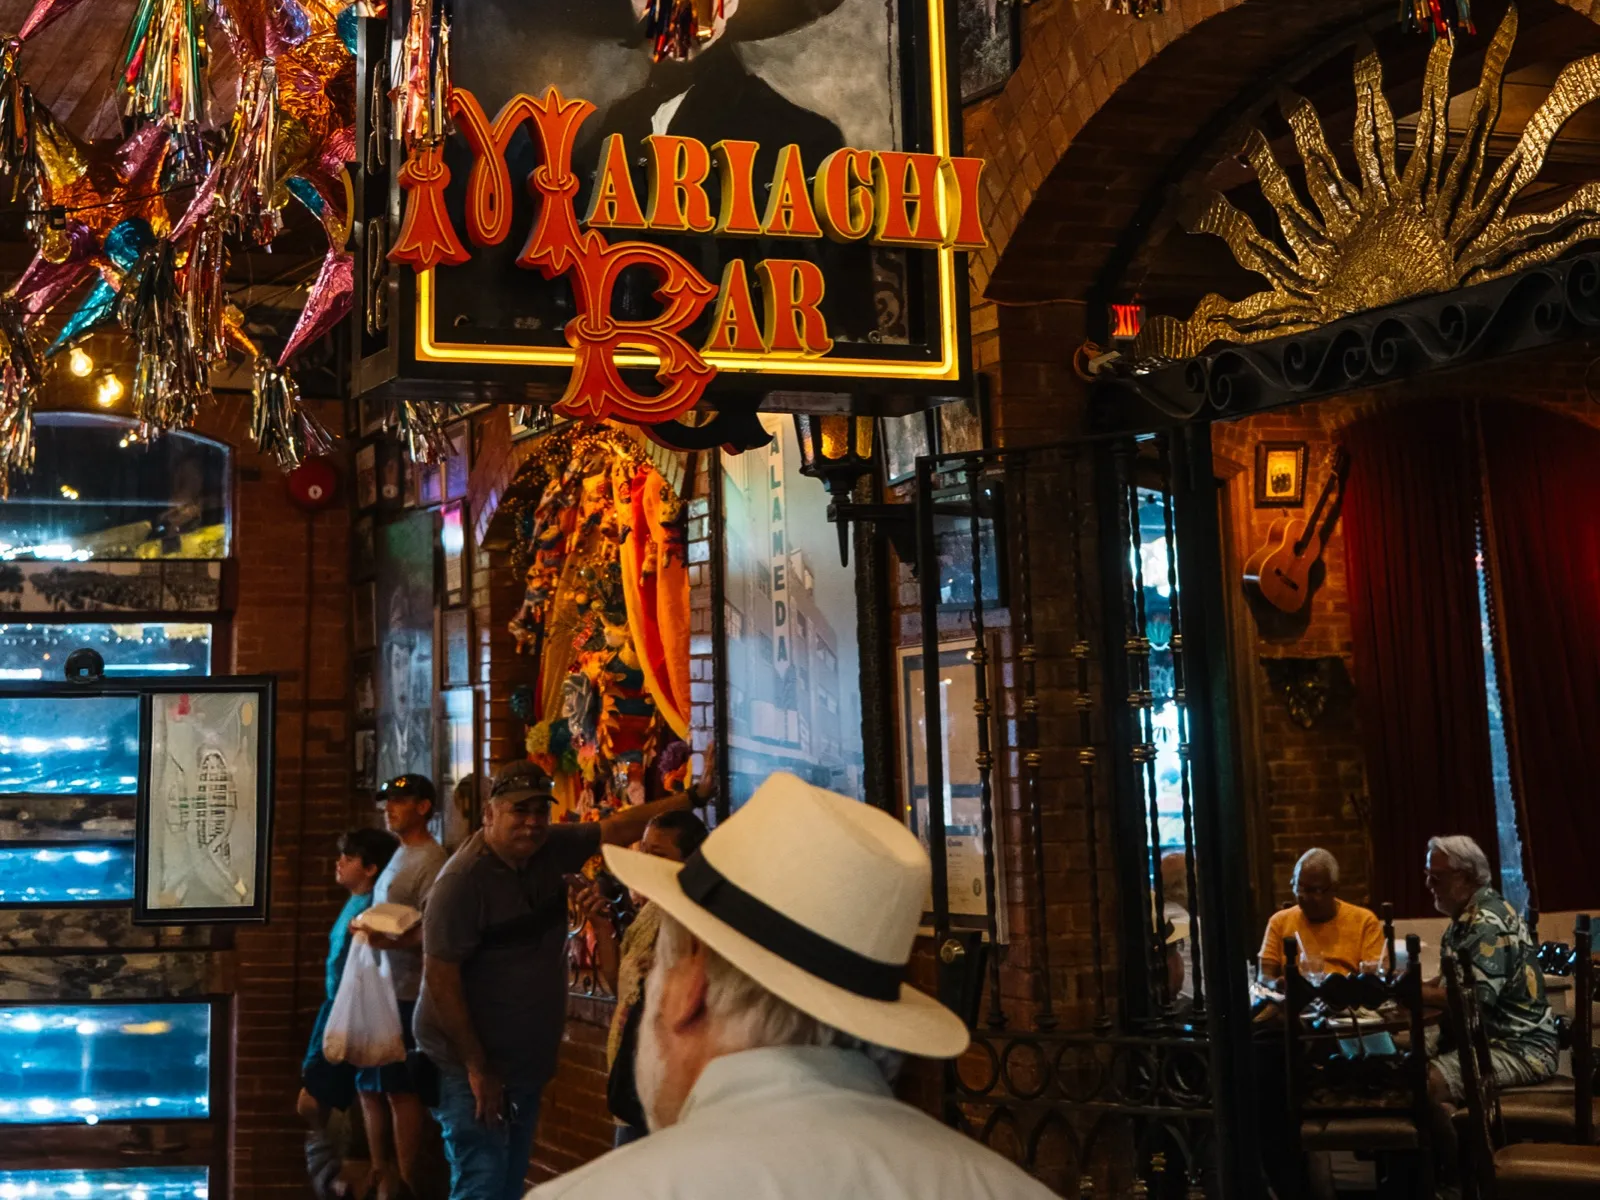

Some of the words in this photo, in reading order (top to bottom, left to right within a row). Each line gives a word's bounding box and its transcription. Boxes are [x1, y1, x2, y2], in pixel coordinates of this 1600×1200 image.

[387, 85, 989, 279] MARIACHI
[552, 229, 834, 425] BAR
[769, 431, 788, 662] ALAMEDA
